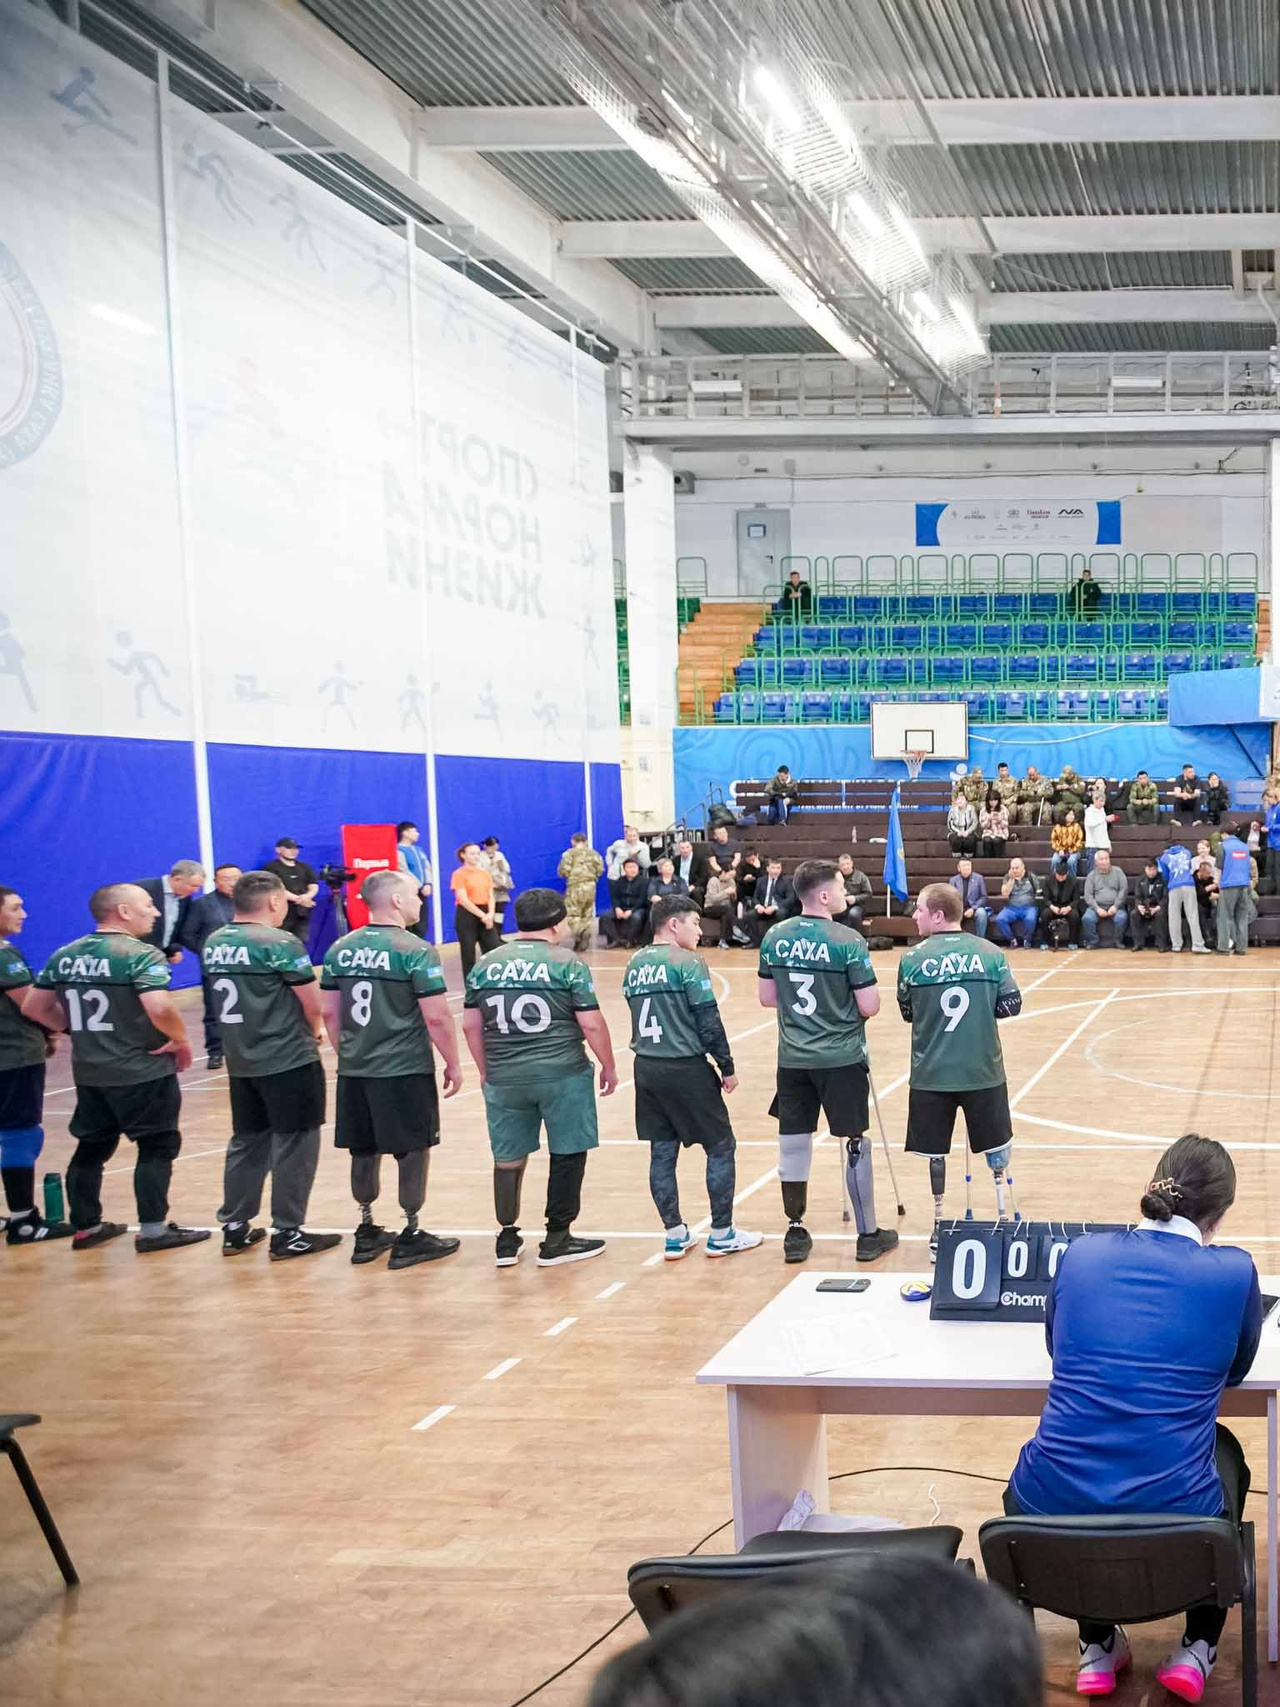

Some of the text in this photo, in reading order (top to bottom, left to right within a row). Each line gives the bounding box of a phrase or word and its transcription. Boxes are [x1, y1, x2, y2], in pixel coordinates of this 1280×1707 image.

[58, 955, 112, 977] САХА
[204, 945, 251, 966] САХА
[337, 947, 391, 971] САХА
[486, 960, 551, 983] САХА
[775, 938, 831, 963] САХА
[921, 953, 985, 978] САХА
[628, 963, 668, 987] САХА
[788, 972, 818, 1017] 3
[65, 988, 114, 1032] 12
[213, 978, 244, 1024] 2
[351, 981, 373, 1027] 8
[485, 993, 551, 1035] 10
[638, 997, 663, 1044] 4
[940, 986, 970, 1032] 9
[952, 1239, 987, 1300] 0
[1007, 1241, 1028, 1278] 0
